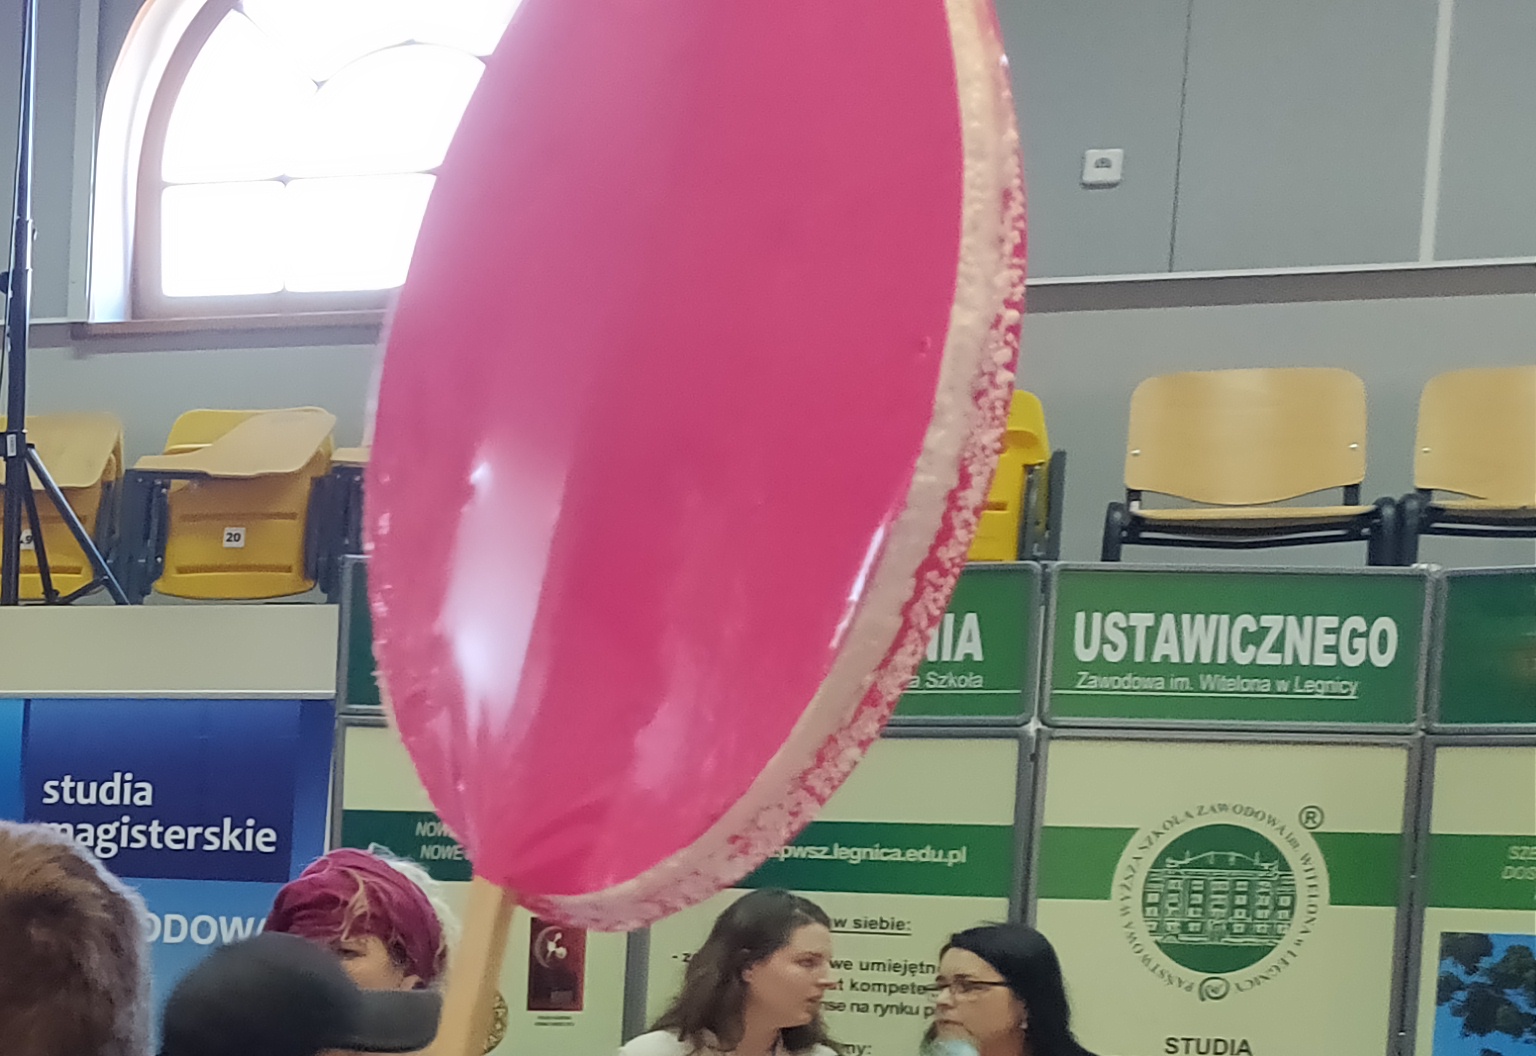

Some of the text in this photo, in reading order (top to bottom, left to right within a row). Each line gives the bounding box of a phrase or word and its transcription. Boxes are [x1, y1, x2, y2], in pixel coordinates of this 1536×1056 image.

[1074, 611, 1398, 667] USTAWICZNEGO
[926, 671, 984, 689] Szkoła
[1076, 672, 1164, 690] Zawodowa
[1200, 674, 1271, 692] Witelona
[42, 772, 153, 806] studia
[771, 843, 967, 867] .pwsz.legnica.edu.pl
[852, 916, 911, 931] siebie:
[859, 957, 937, 977] umiejętn
[849, 979, 928, 996] kompete
[1165, 1037, 1253, 1056] STUDIA
